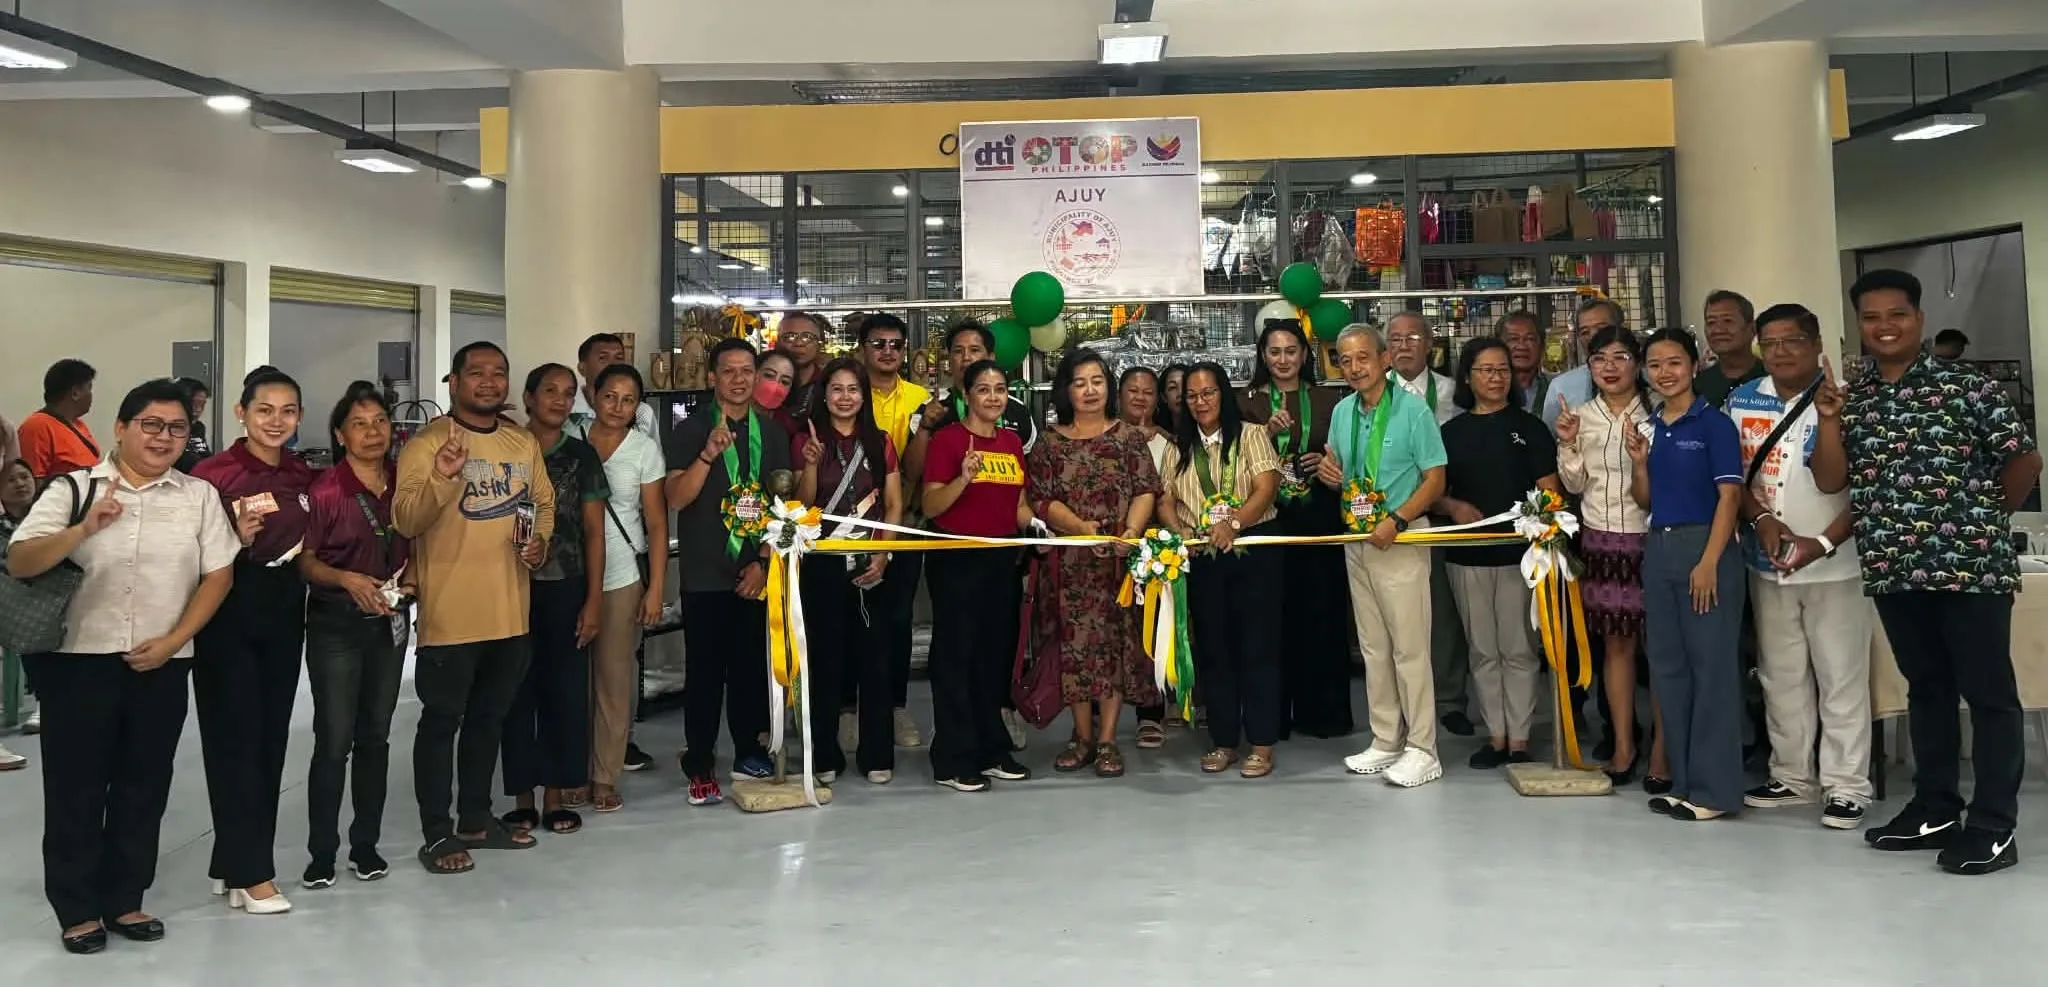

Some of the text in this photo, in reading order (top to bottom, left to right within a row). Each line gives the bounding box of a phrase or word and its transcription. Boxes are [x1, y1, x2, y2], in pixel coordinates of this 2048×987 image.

[975, 133, 1016, 165] dti
[1022, 136, 1137, 165] OTOP
[1031, 164, 1127, 173] PHILIPPINES
[1055, 188, 1106, 203] AJUY
[980, 460, 1016, 475] AJUY
